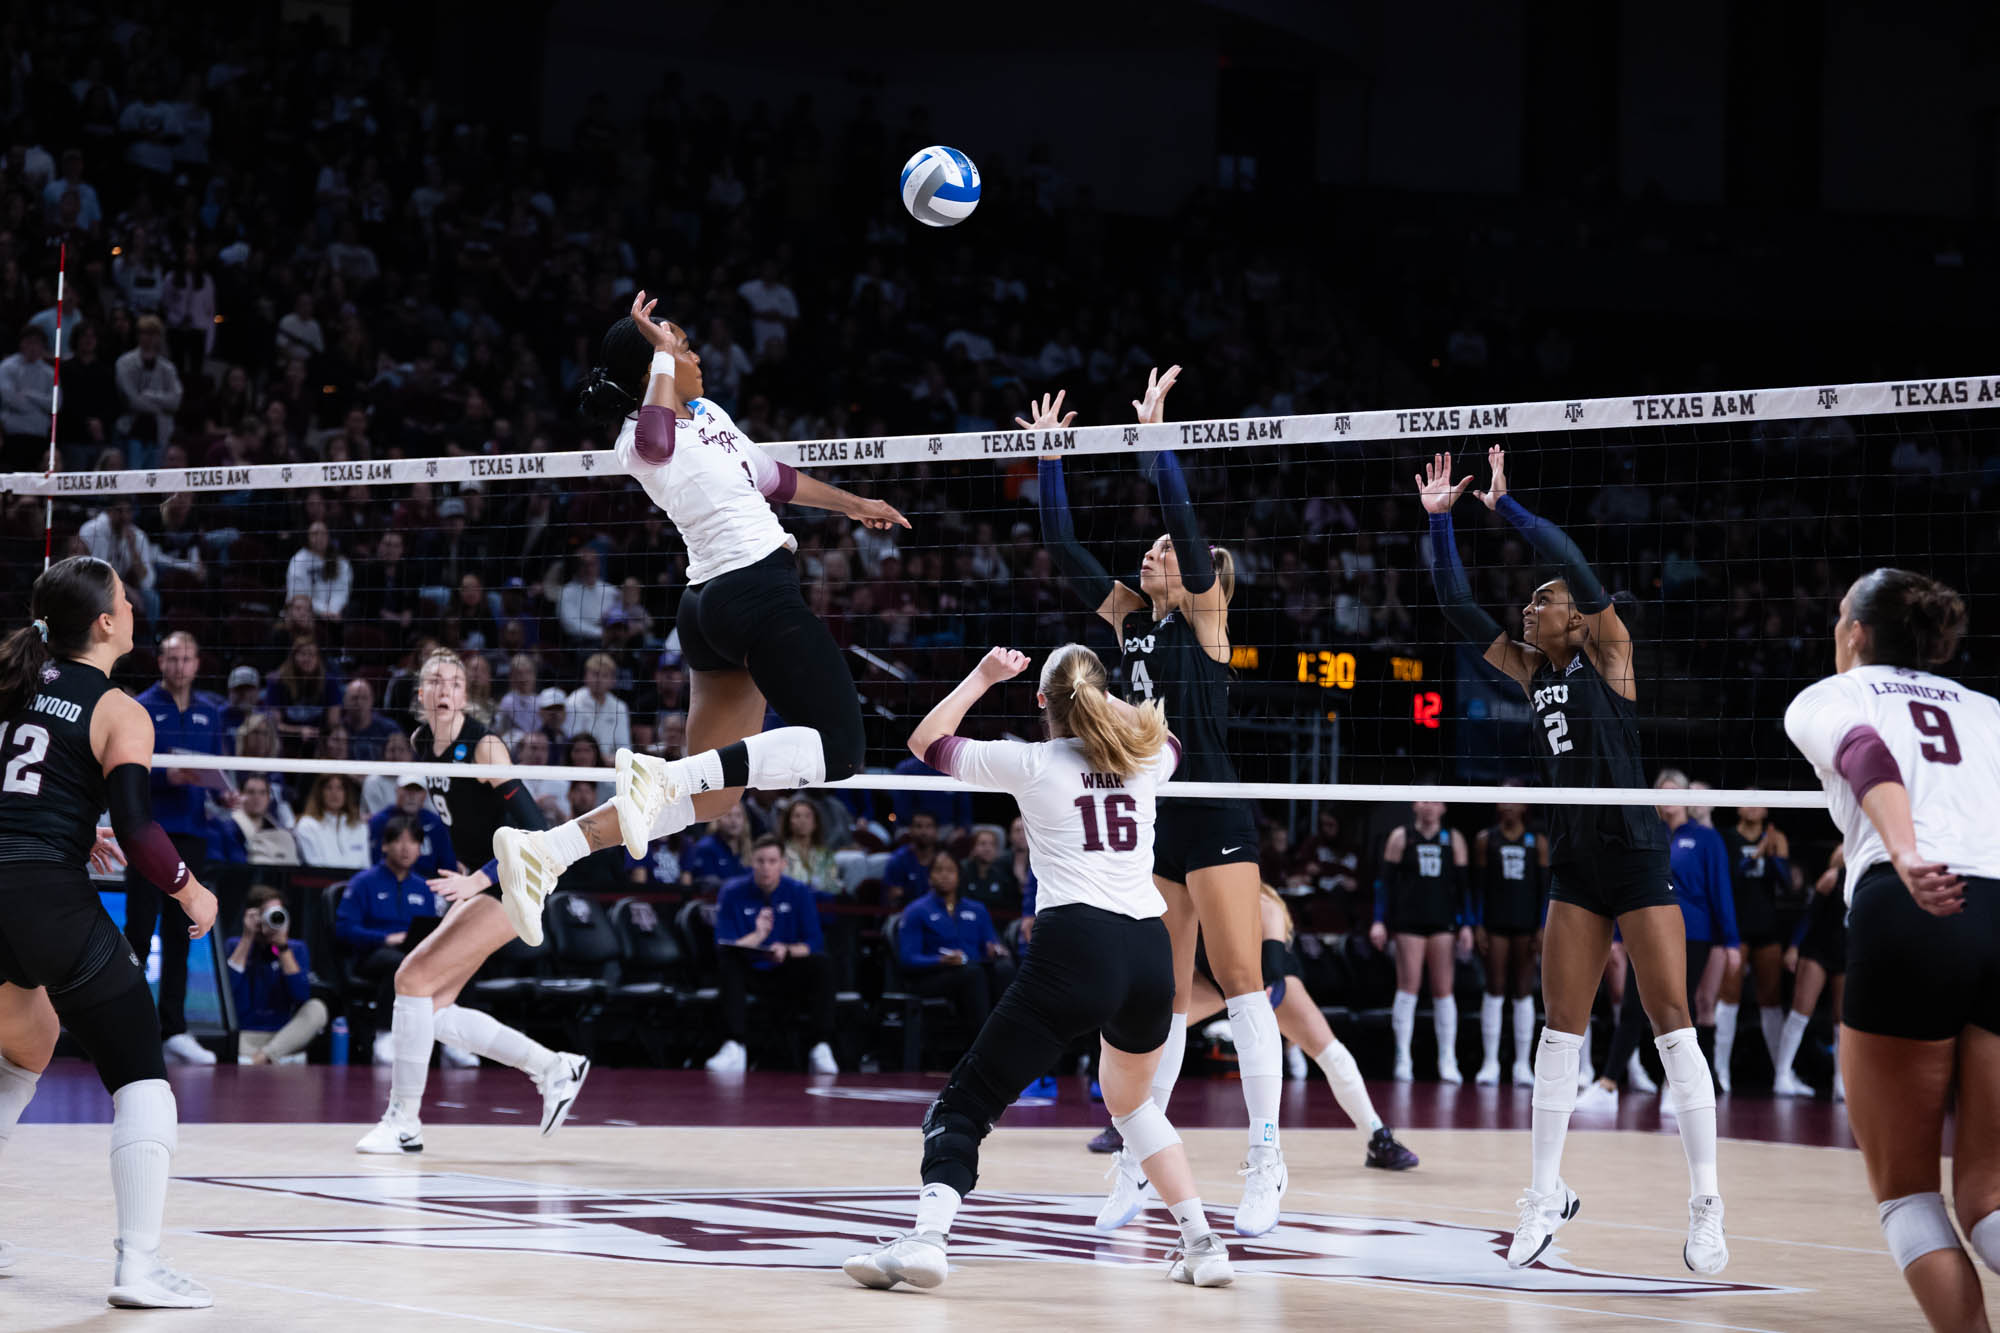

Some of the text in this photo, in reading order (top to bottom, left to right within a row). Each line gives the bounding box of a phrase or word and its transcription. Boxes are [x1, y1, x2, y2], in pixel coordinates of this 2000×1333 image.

[1891, 381, 1968, 407] TEXAS
[1396, 407, 1509, 432] TEXAS A&M
[1632, 394, 1756, 421] TEXAS A&M
[981, 431, 1077, 453] TEXAS A&M
[1179, 420, 1282, 444] TEXAS A&M
[798, 440, 885, 462] TEXAS A&M
[184, 469, 251, 487] TEXAS A&M
[321, 463, 392, 482] TEXAS A&M
[469, 456, 545, 476] TEXAS A&M
[56, 474, 118, 491] TEXAS A&M
[1131, 659, 1154, 698] 4
[1297, 650, 1357, 690] 1:30
[29, 694, 82, 723] WOOD
[1413, 691, 1443, 728] 12
[1543, 711, 1574, 755] 2
[1908, 700, 1962, 765] 9
[1074, 794, 1137, 851] 16
[1419, 856, 1441, 877] 10
